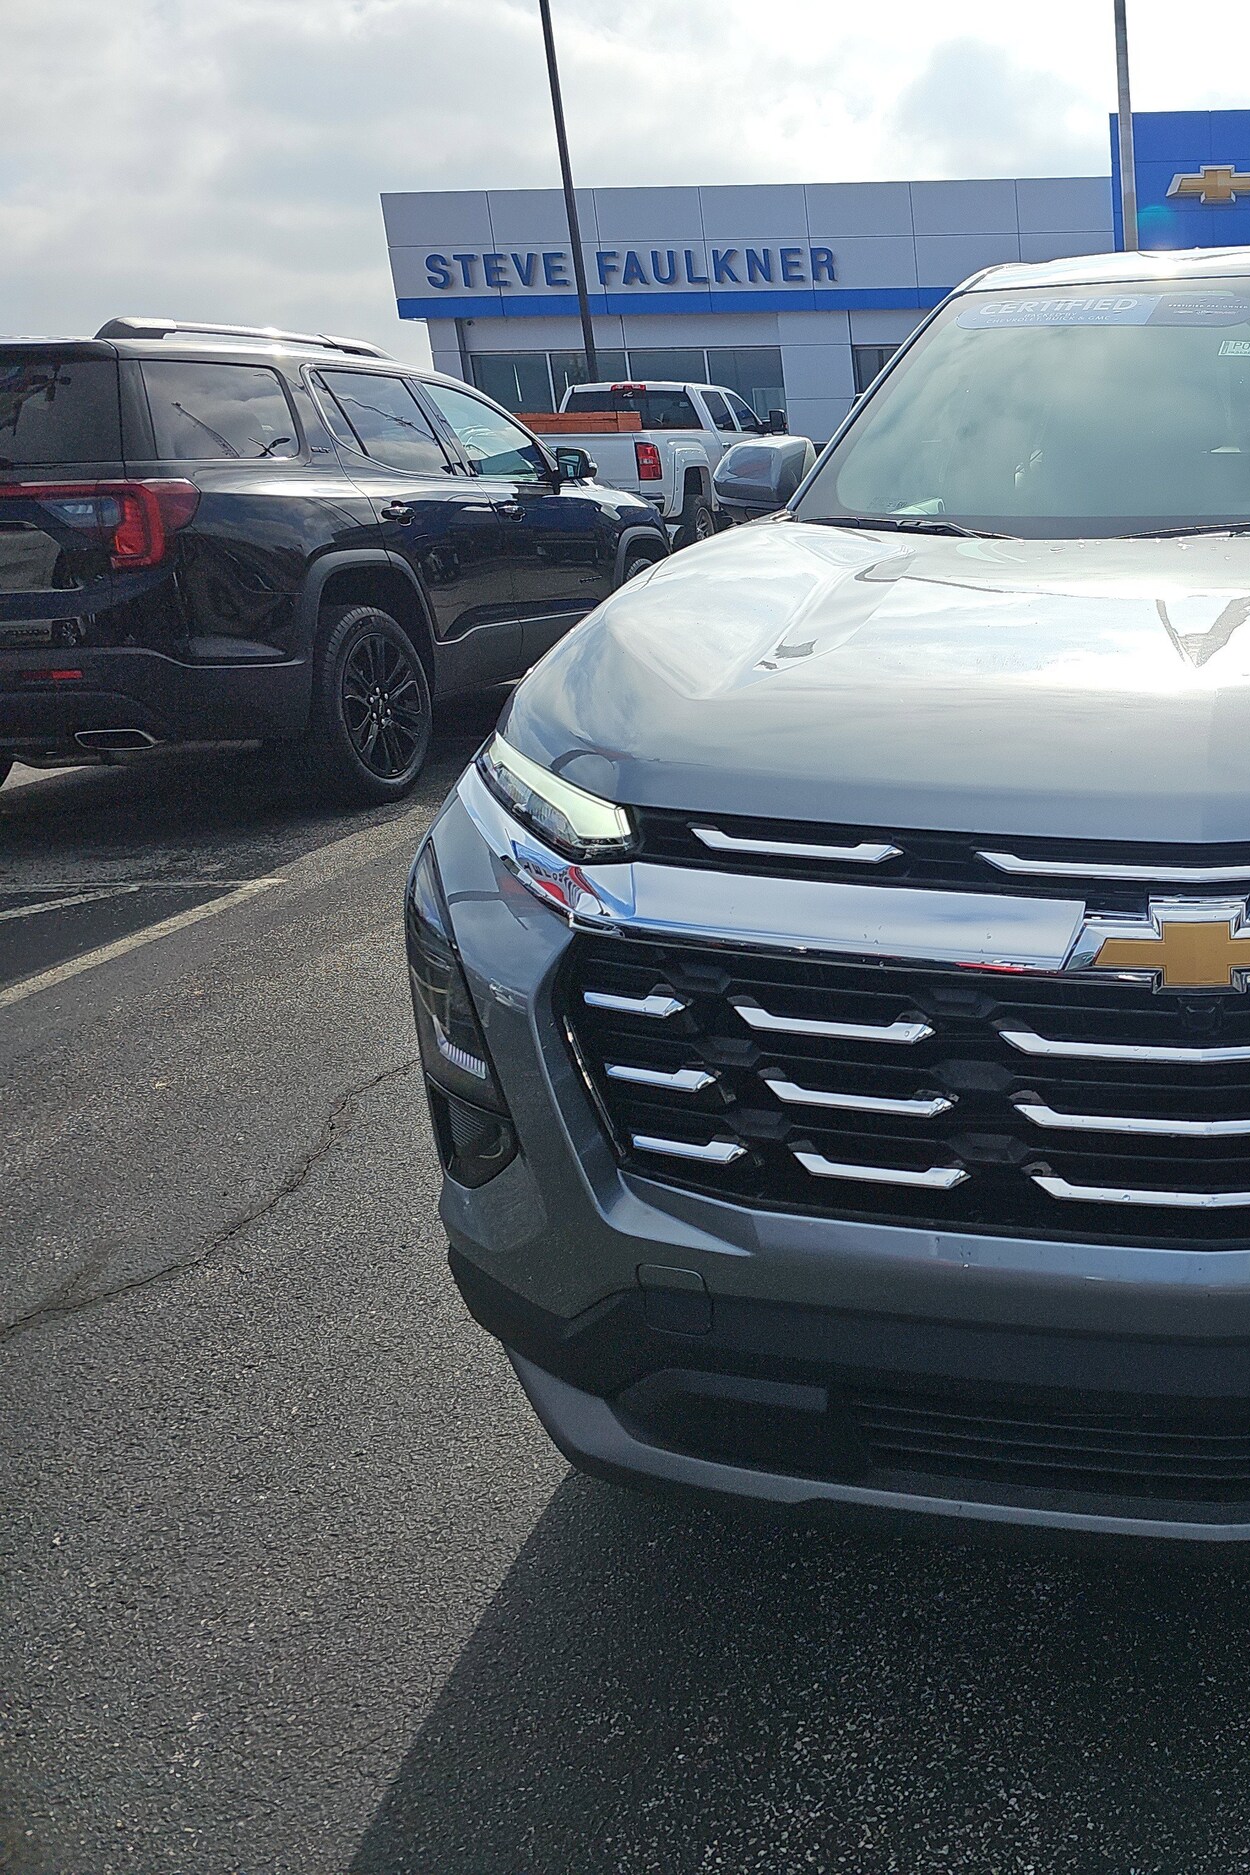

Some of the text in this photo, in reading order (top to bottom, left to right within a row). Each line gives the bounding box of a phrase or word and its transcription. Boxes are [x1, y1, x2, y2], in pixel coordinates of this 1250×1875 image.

[425, 247, 839, 289] STEVE FAULKNER
[979, 297, 1138, 316] CERTIFIED
